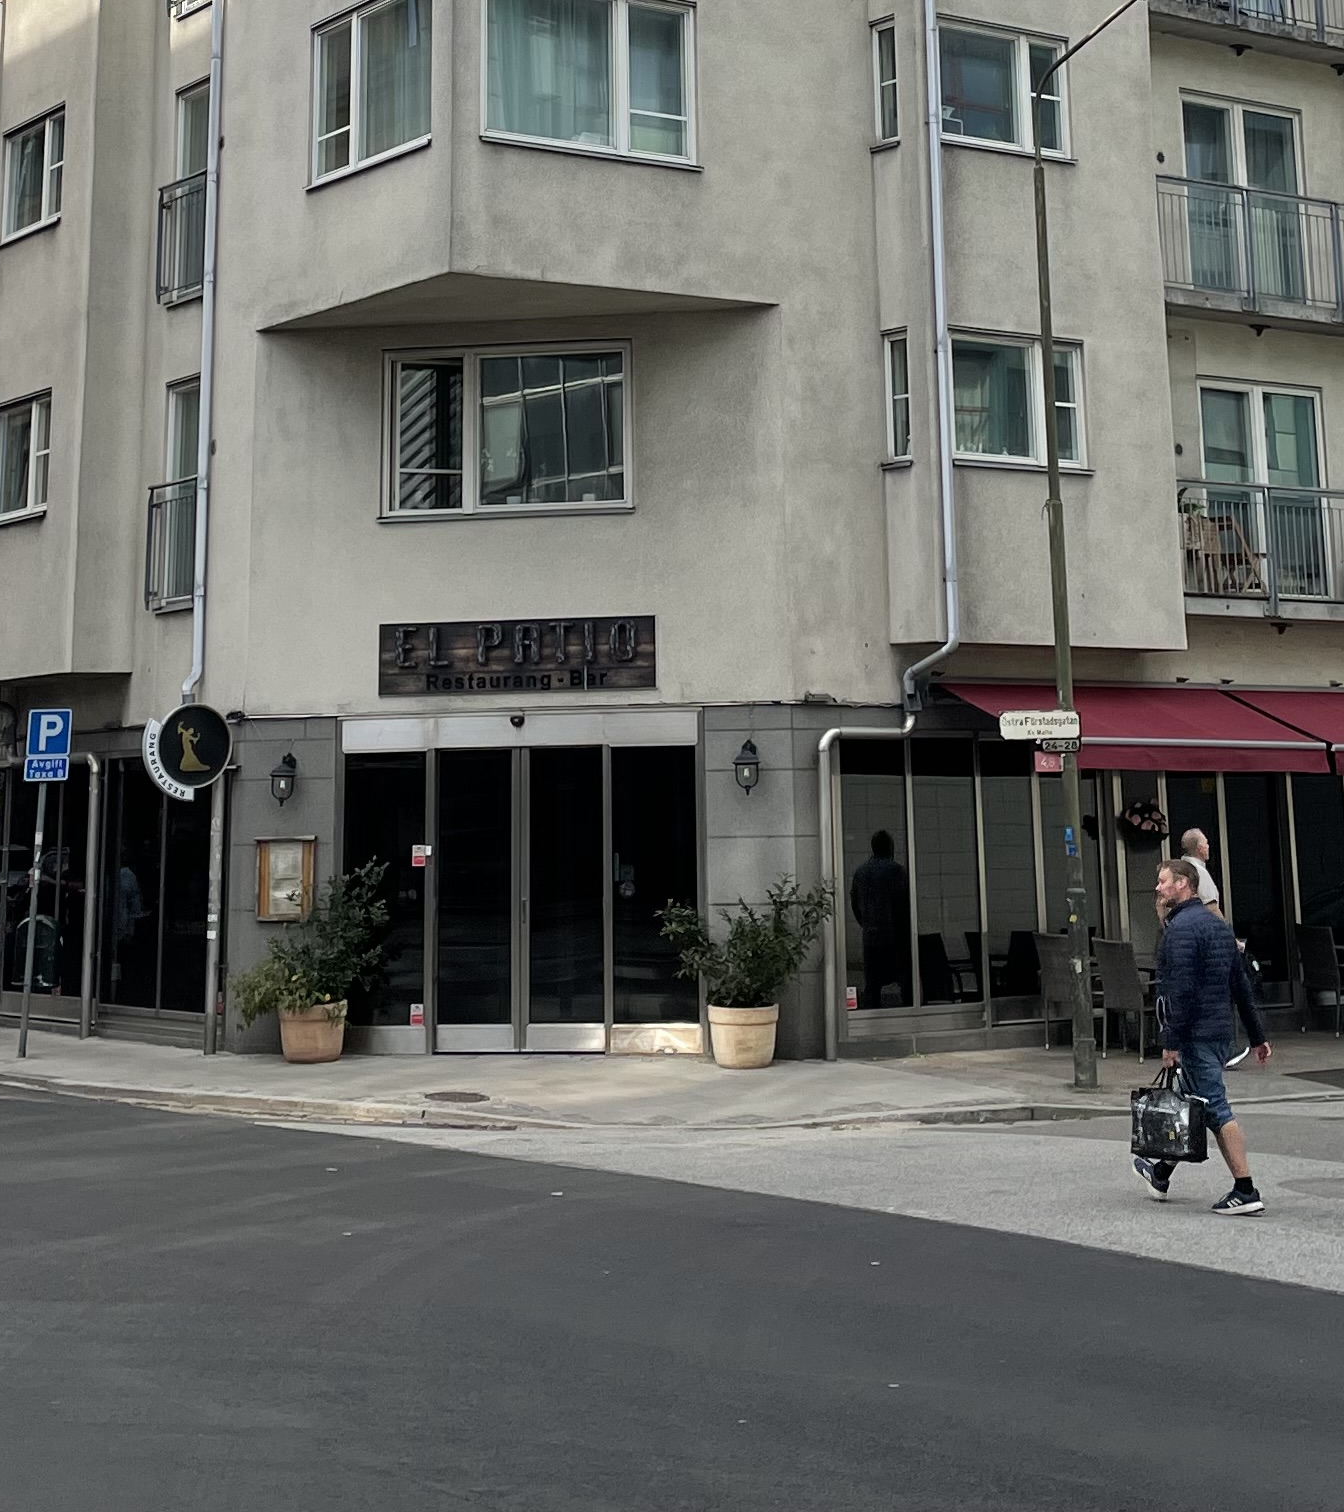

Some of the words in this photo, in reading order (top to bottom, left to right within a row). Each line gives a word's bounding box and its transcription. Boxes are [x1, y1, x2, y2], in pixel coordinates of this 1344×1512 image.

[395, 626, 449, 668] EL
[476, 620, 637, 666] PATIO
[425, 673, 552, 691] Restaurang
[569, 670, 608, 688] Bar
[38, 714, 64, 752] P
[1044, 741, 1078, 751] 24-28
[29, 769, 54, 778] Taxa
[31, 759, 63, 770] Avgift
[148, 733, 186, 797] RESTAURANG
